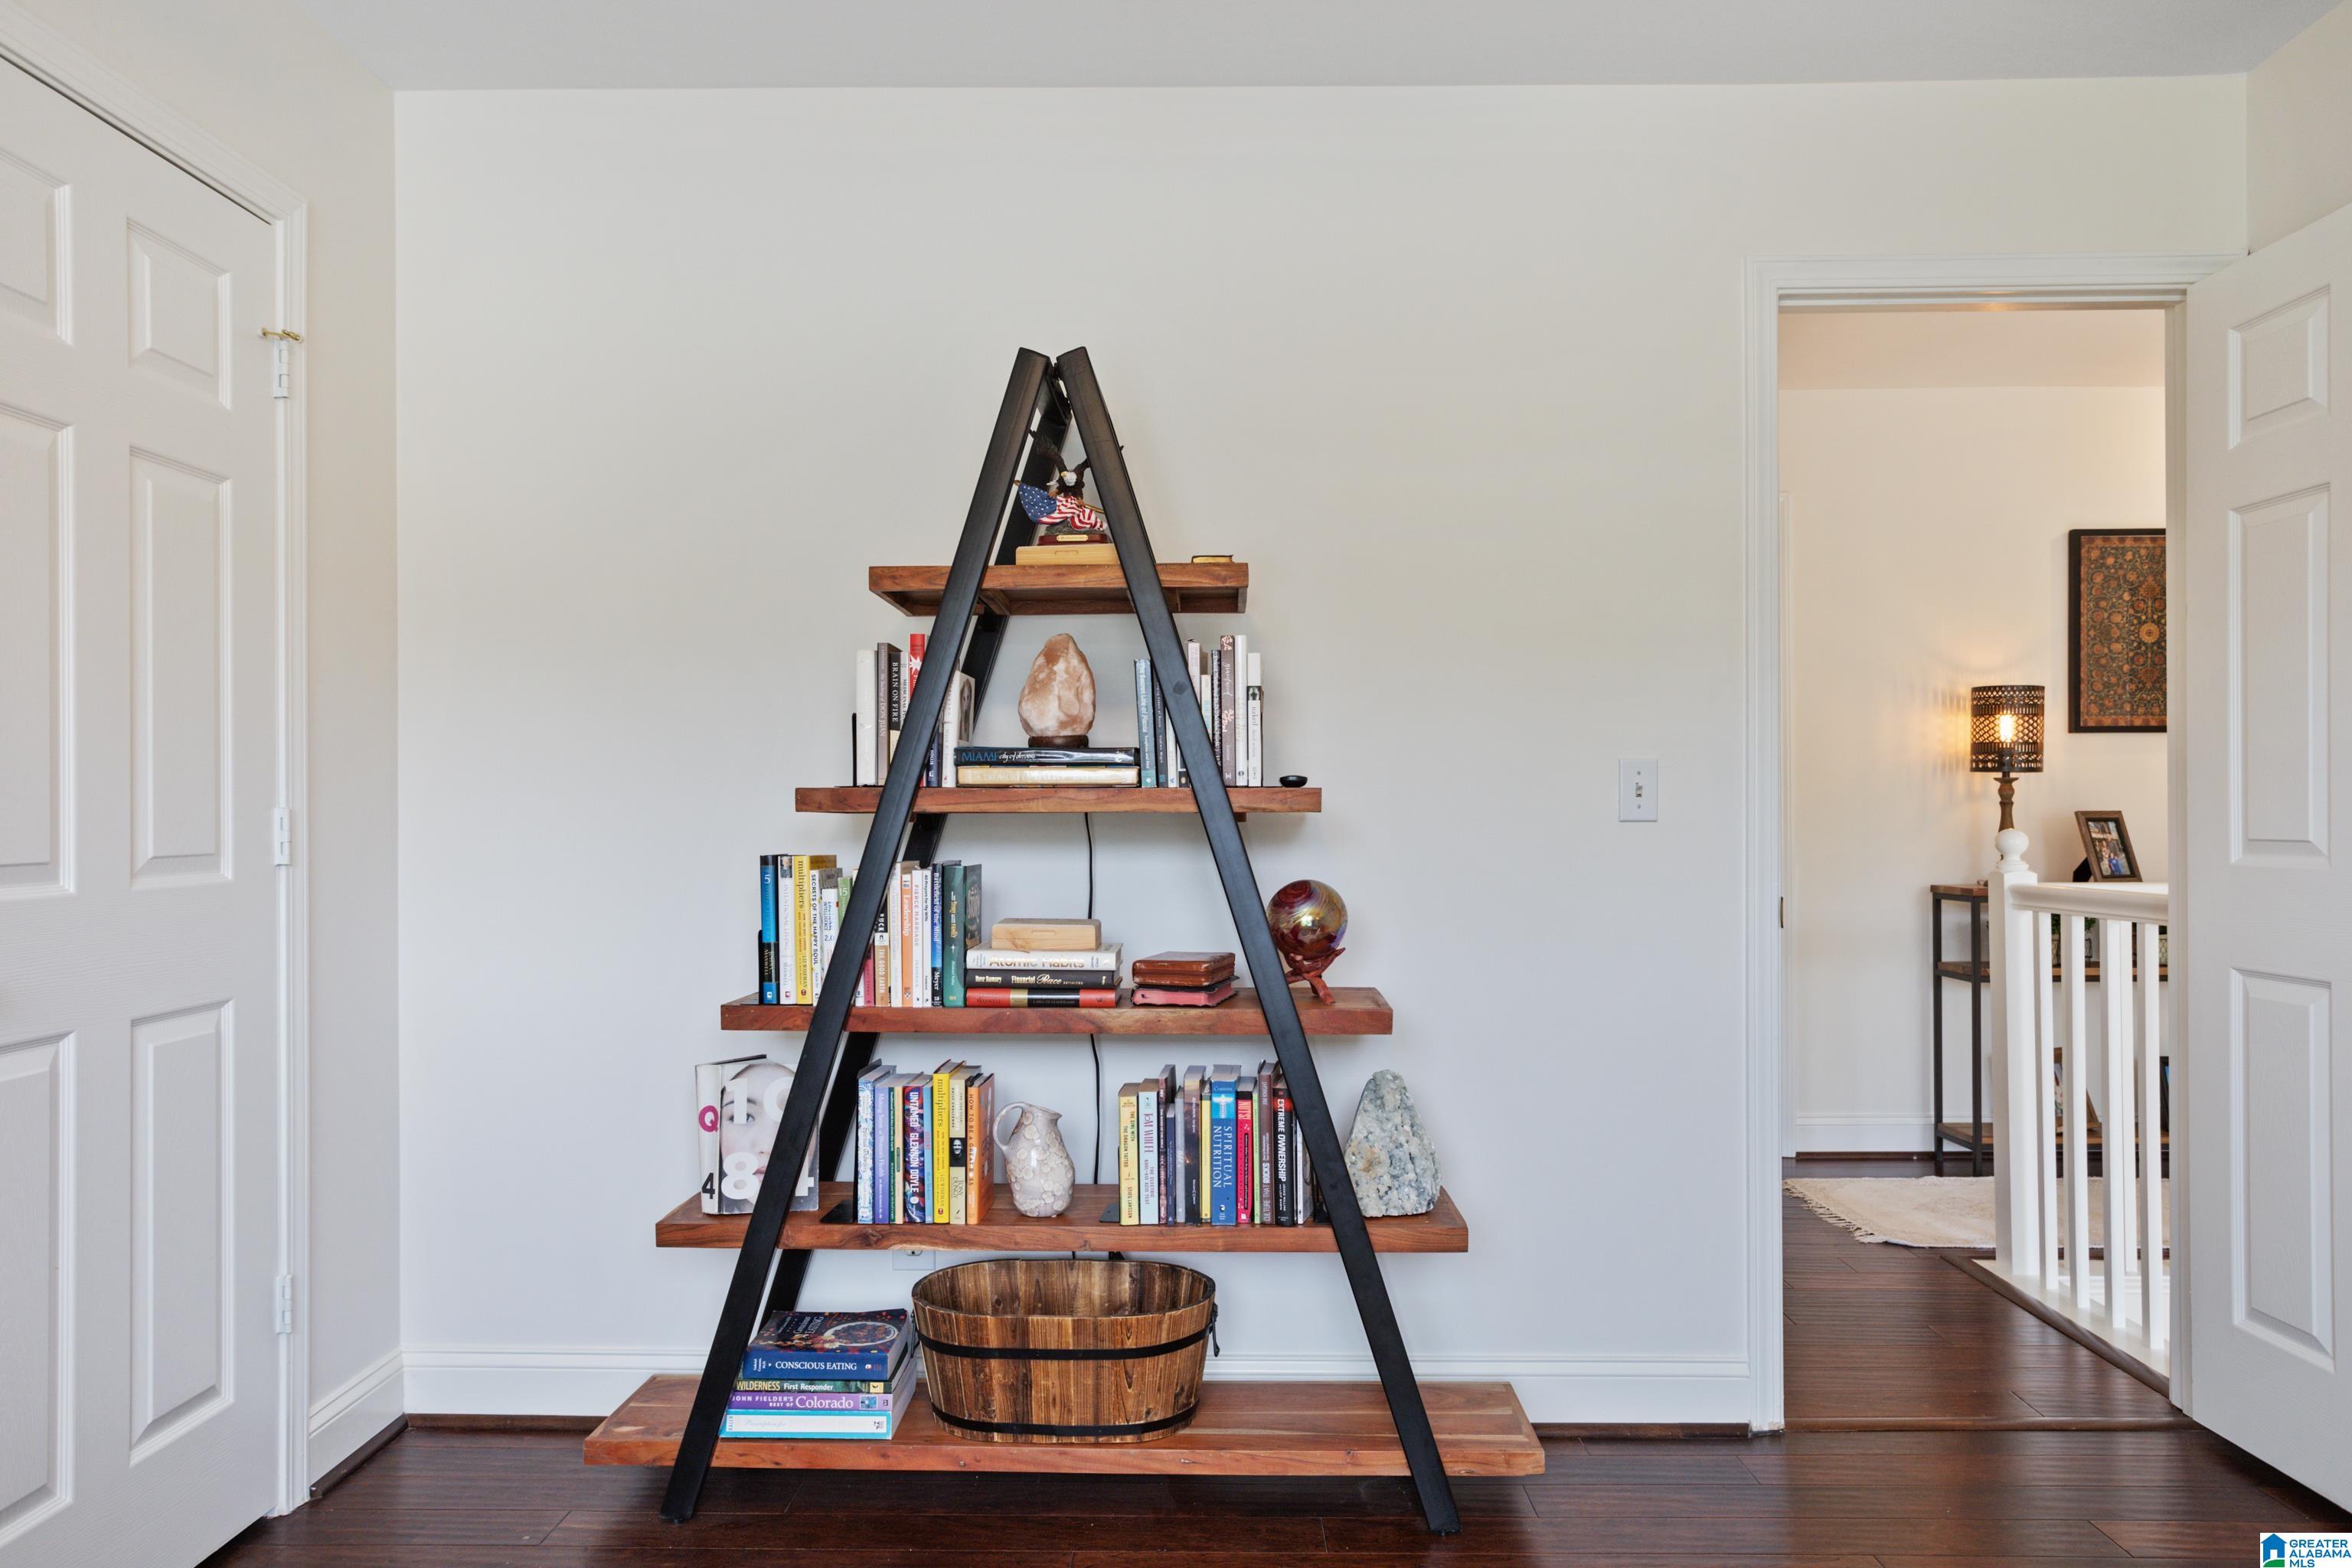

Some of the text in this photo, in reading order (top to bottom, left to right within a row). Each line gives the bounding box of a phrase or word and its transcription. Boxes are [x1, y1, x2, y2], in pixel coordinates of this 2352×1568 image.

[892, 690, 898, 701] ON
[962, 753, 996, 761] MIAMI
[764, 874, 770, 884] 5
[796, 861, 806, 909] multipliers
[812, 903, 817, 911] OF
[903, 893, 911, 936] Leadership
[989, 956, 1038, 967] Atomic
[1042, 956, 1084, 968] Habits
[986, 975, 1002, 984] Ramsey
[1011, 975, 1036, 984] Financial
[1036, 974, 1061, 985] Peace
[935, 1079, 946, 1127] multipliers
[1237, 1101, 1251, 1119] NUTS!
[698, 1105, 719, 1132] Q
[969, 1113, 974, 1122] TO
[1144, 1113, 1154, 1127] TOM
[969, 1125, 974, 1133] BE
[910, 1092, 919, 1192] UNTAMED GLENNON DOYLE
[1278, 1134, 1286, 1181] OWNERSHIP
[701, 1172, 715, 1200] 4
[826, 1362, 857, 1370] EATING
[737, 1381, 780, 1390] WILDERNESS
[795, 1396, 853, 1409] Colorado
